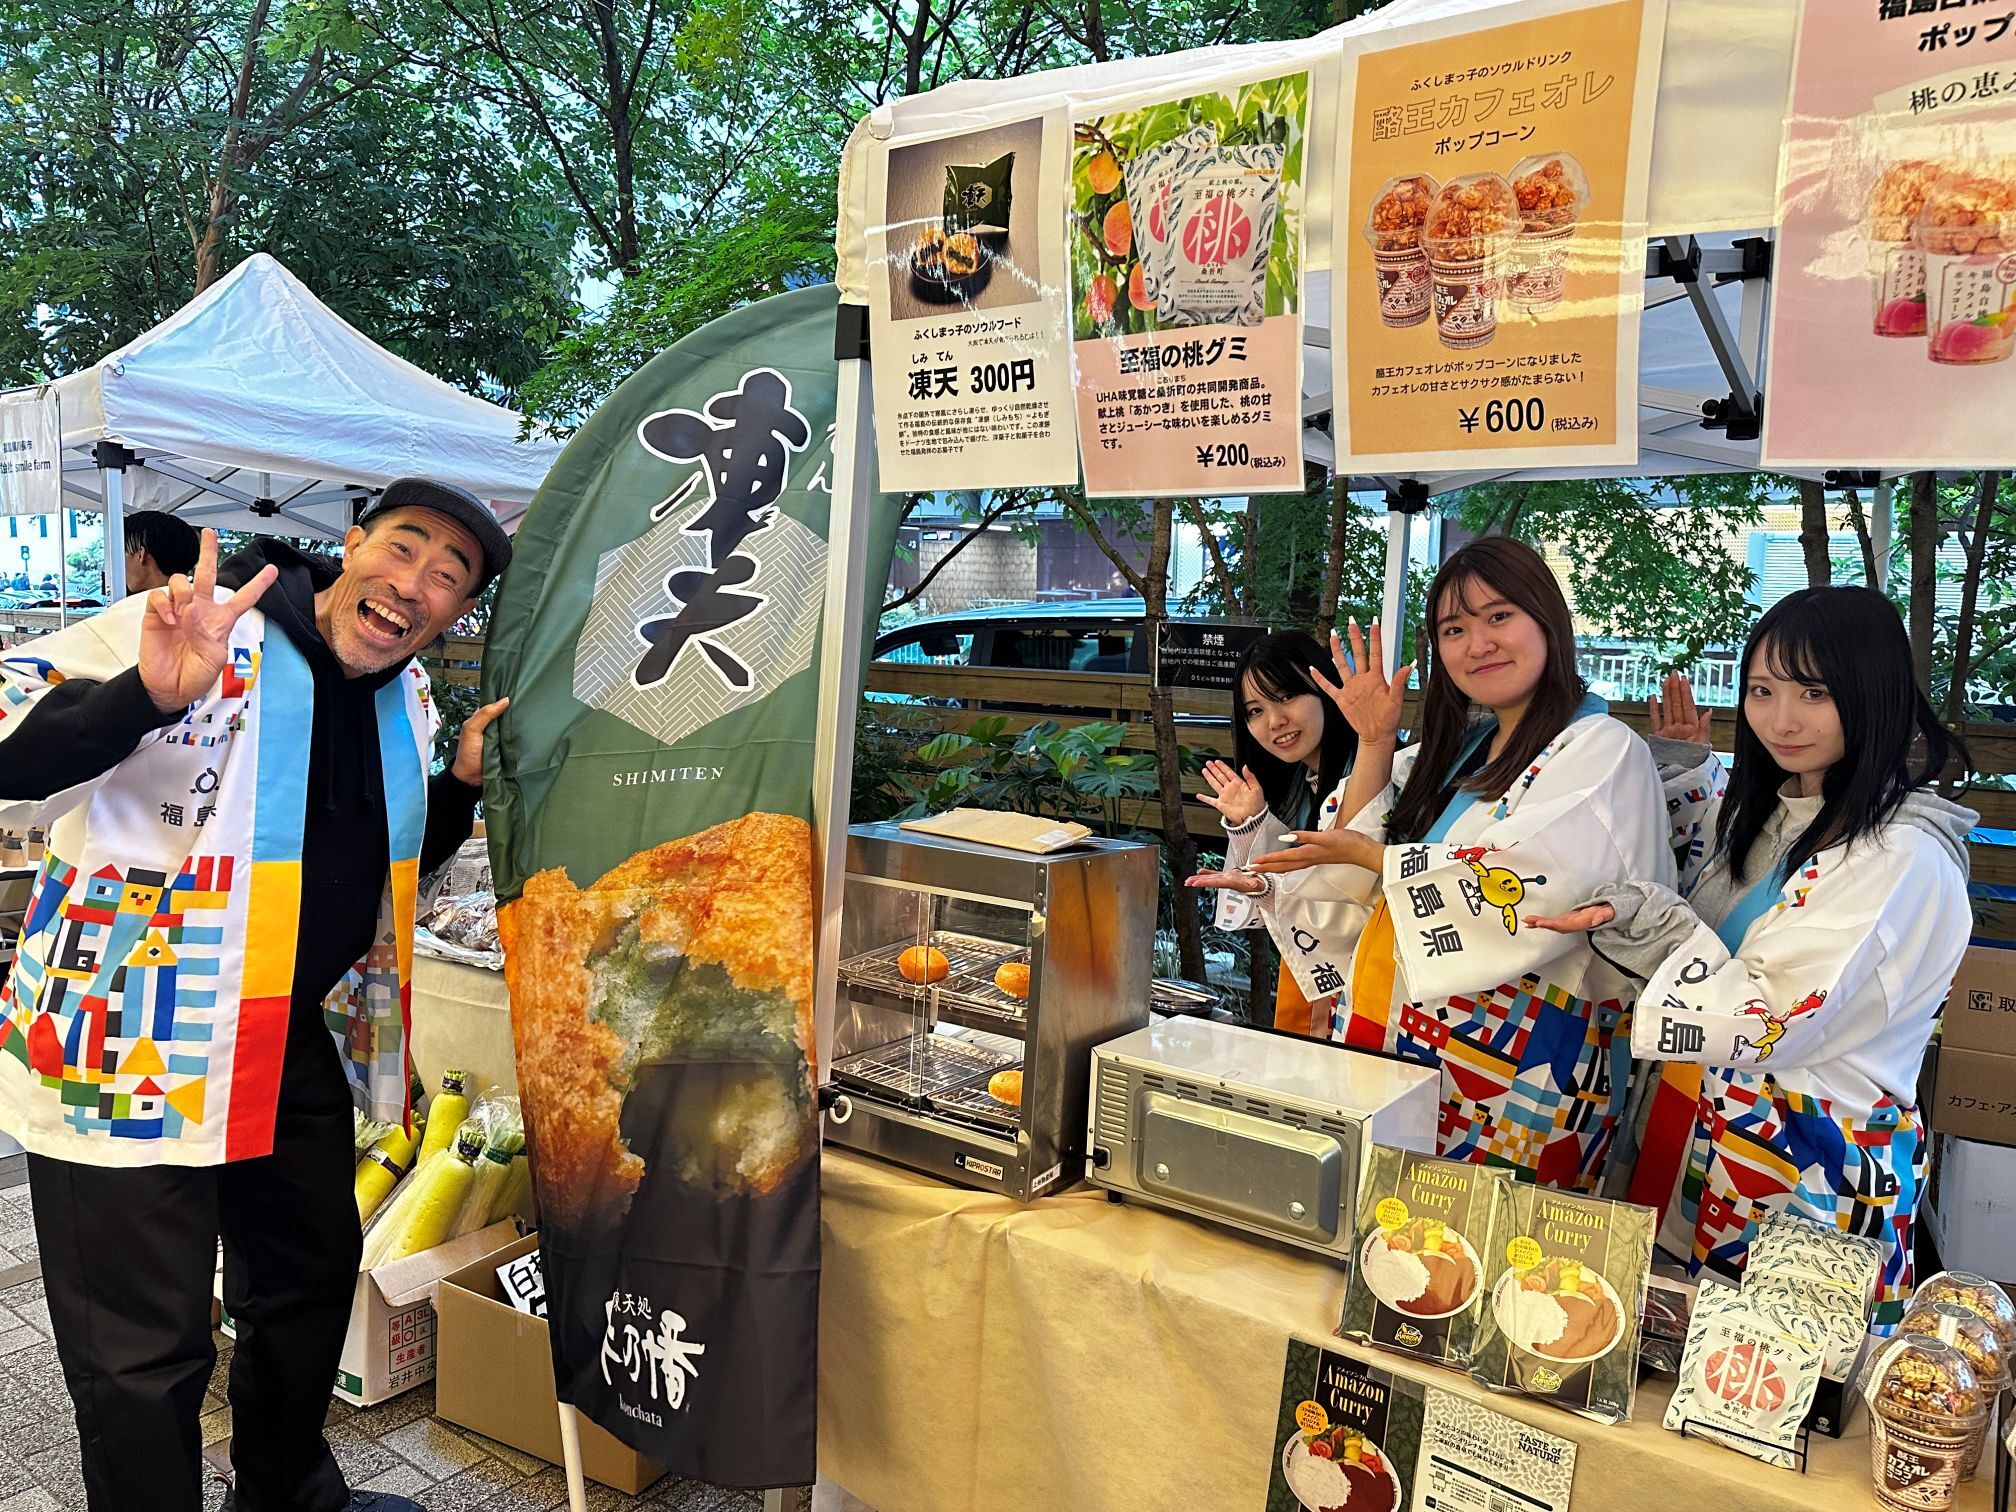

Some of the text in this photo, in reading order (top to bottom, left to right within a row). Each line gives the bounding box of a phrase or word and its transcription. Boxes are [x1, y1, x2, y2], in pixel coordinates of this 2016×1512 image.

[1918, 11, 2016, 52] ポップ
[1411, 51, 1573, 91] ふくしまっ子のソウルドリンク
[1373, 71, 1615, 142] 酪王カフェオレ
[1434, 125, 1536, 155] ポップコーン
[1183, 195, 1252, 266] 桃
[914, 317, 1022, 341] ふくしまっ子のソウルフード
[912, 351, 954, 364] しみ てん
[1120, 337, 1248, 375] 至福の桃グミ
[1375, 352, 1582, 379] 酪王カフェオレがポップコーンになりました
[908, 358, 1036, 400] 凍天 300円
[1096, 377, 1267, 403] UHA味覚糖と桑折町の共同開発商品。
[1371, 370, 1585, 396] カフェオレの甘さとサクサク感がたまらない！
[1097, 393, 1272, 419] 献上桃「あかつき」を使用した、桃の甘
[1458, 397, 1598, 433] ¥600 (税込み)
[1099, 410, 1272, 434] さとジューシーな味わいを楽しめるグミ
[1100, 438, 1123, 450] です。
[1196, 443, 1286, 469] ¥200 (税込み)
[1202, 633, 1225, 646] 禁煙
[612, 766, 725, 787] SHIMITEN
[1400, 844, 1464, 958] 福島県
[1310, 961, 1345, 994] 福
[1405, 1162, 1468, 1192] Amazon
[1412, 1183, 1456, 1215] Curry
[1537, 1199, 1604, 1230] Amazon
[1544, 1221, 1593, 1254] Curry
[395, 1343, 426, 1365] 生産者
[1720, 1326, 1793, 1362] 至福の桃グミ
[1323, 1364, 1385, 1404] Amazon
[1705, 1343, 1786, 1412] 桃
[1330, 1387, 1374, 1426] Curry
[1518, 1441, 1560, 1465] NATURE
[1519, 1432, 1563, 1456] TASTE of
[1888, 1454, 1931, 1477] カフェオレ
